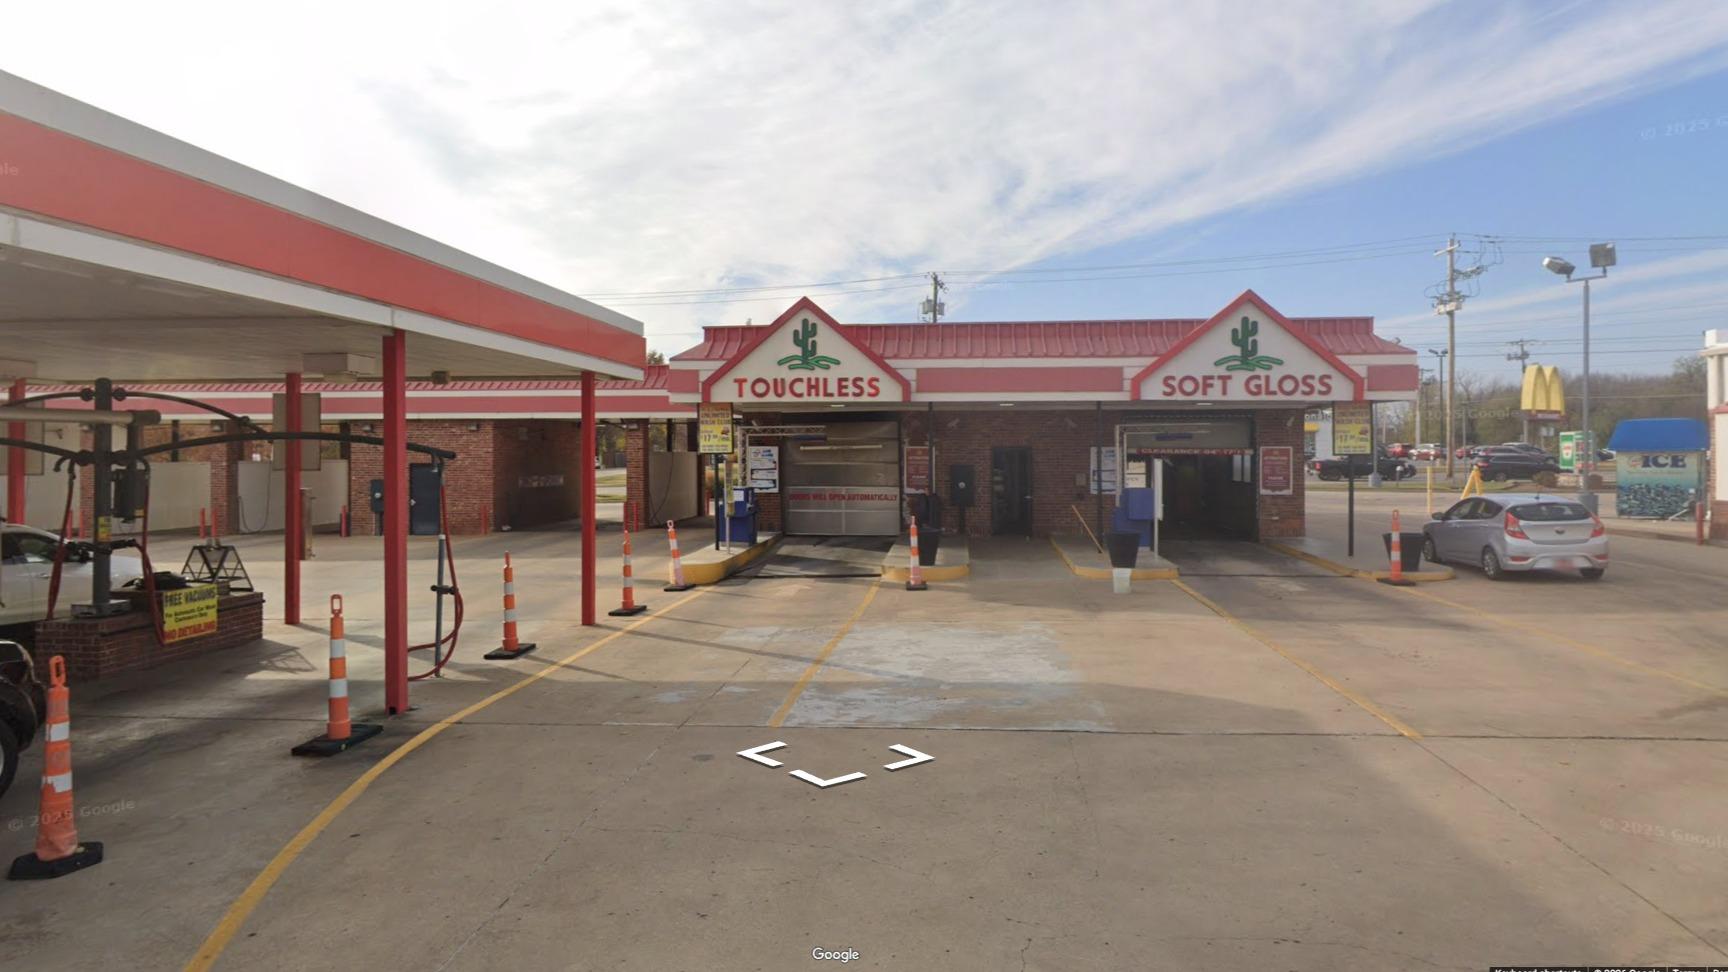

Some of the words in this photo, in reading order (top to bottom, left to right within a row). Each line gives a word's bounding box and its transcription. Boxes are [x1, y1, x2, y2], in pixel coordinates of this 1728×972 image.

[733, 376, 881, 399] TOUCHLESS
[1162, 374, 1232, 396] SOFT
[1244, 373, 1333, 396] GLOSS
[1642, 455, 1686, 468] ICE
[847, 493, 897, 501] AUTOMATICALLY
[165, 592, 183, 607] FREE
